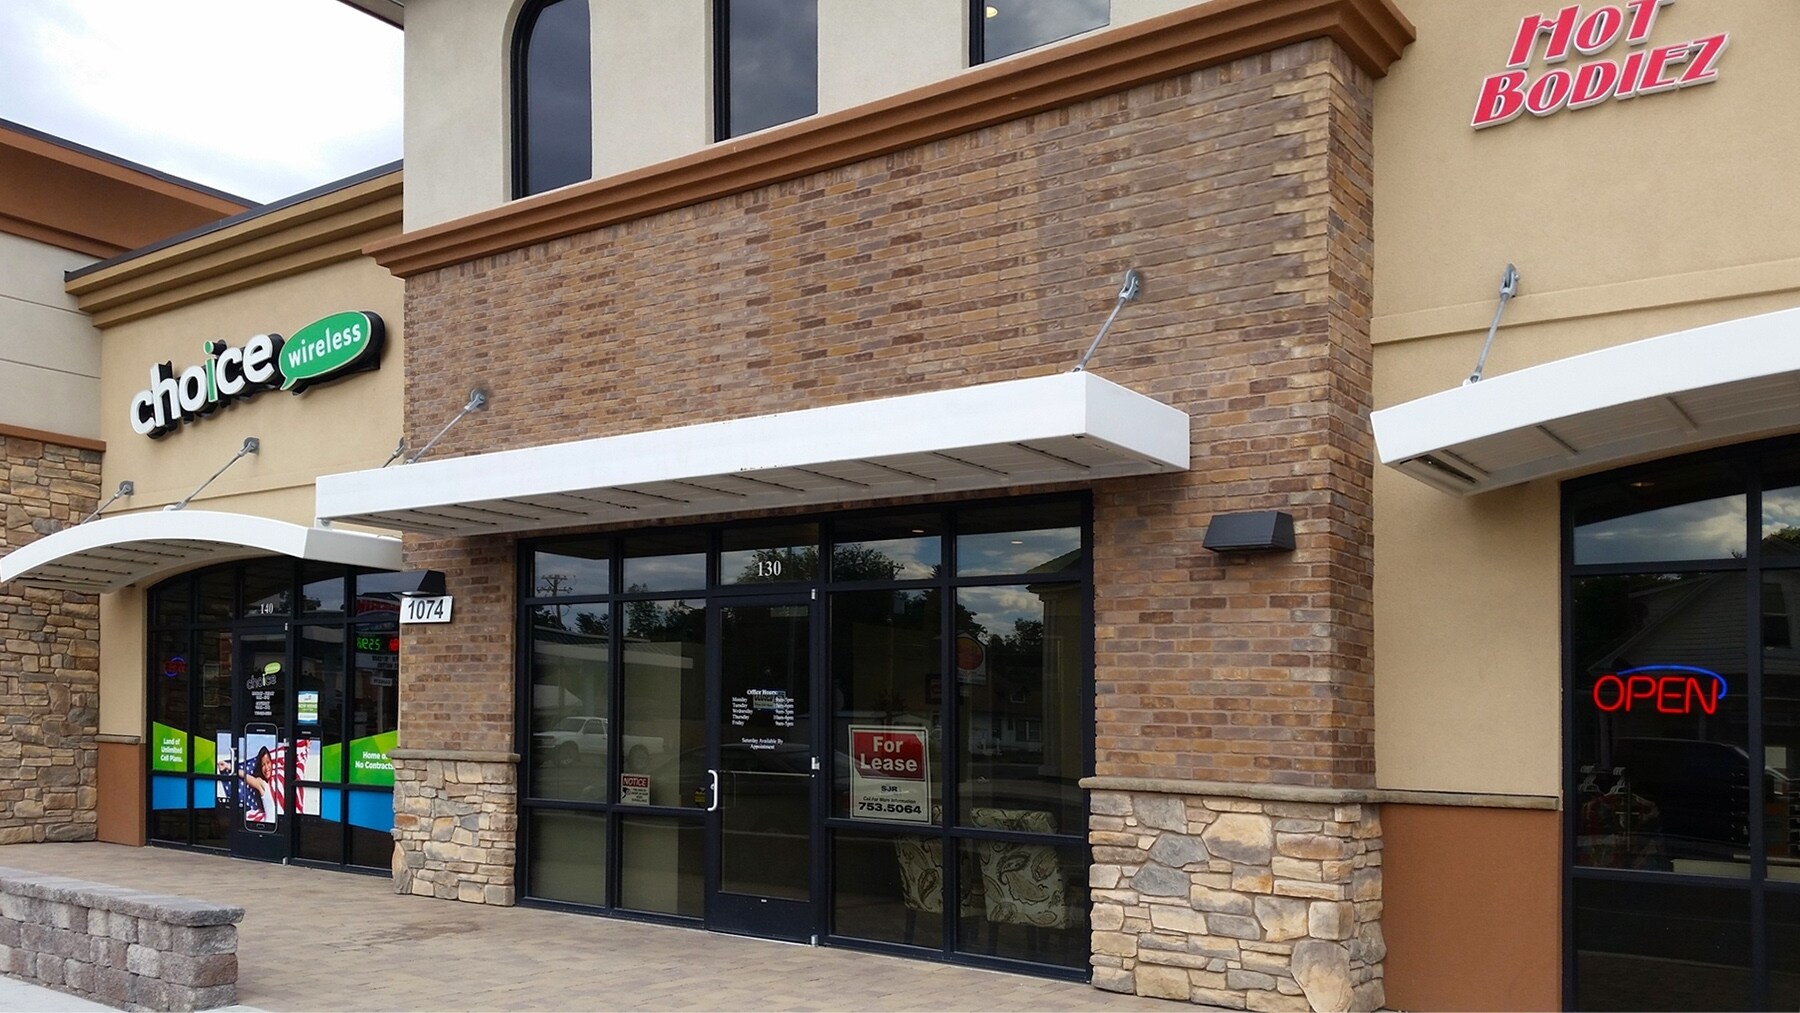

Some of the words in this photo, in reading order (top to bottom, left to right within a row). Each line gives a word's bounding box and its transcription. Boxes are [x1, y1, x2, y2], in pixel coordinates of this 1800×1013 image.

[1506, 0, 1672, 69] HOT
[1471, 32, 1730, 128] BODIEZ
[287, 322, 362, 369] wireless
[130, 333, 276, 435] choice
[758, 560, 781, 576] 130
[260, 602, 274, 614] 140
[408, 599, 444, 620] 1074
[246, 673, 277, 690] choice
[1593, 674, 1719, 715] OPEN
[160, 746, 183, 754] Unlimited
[873, 736, 904, 753] For
[362, 751, 381, 759] Home
[860, 753, 918, 772] Lease
[354, 760, 364, 769] No
[623, 777, 648, 786] NOTICE
[858, 801, 922, 814] 753.5064
